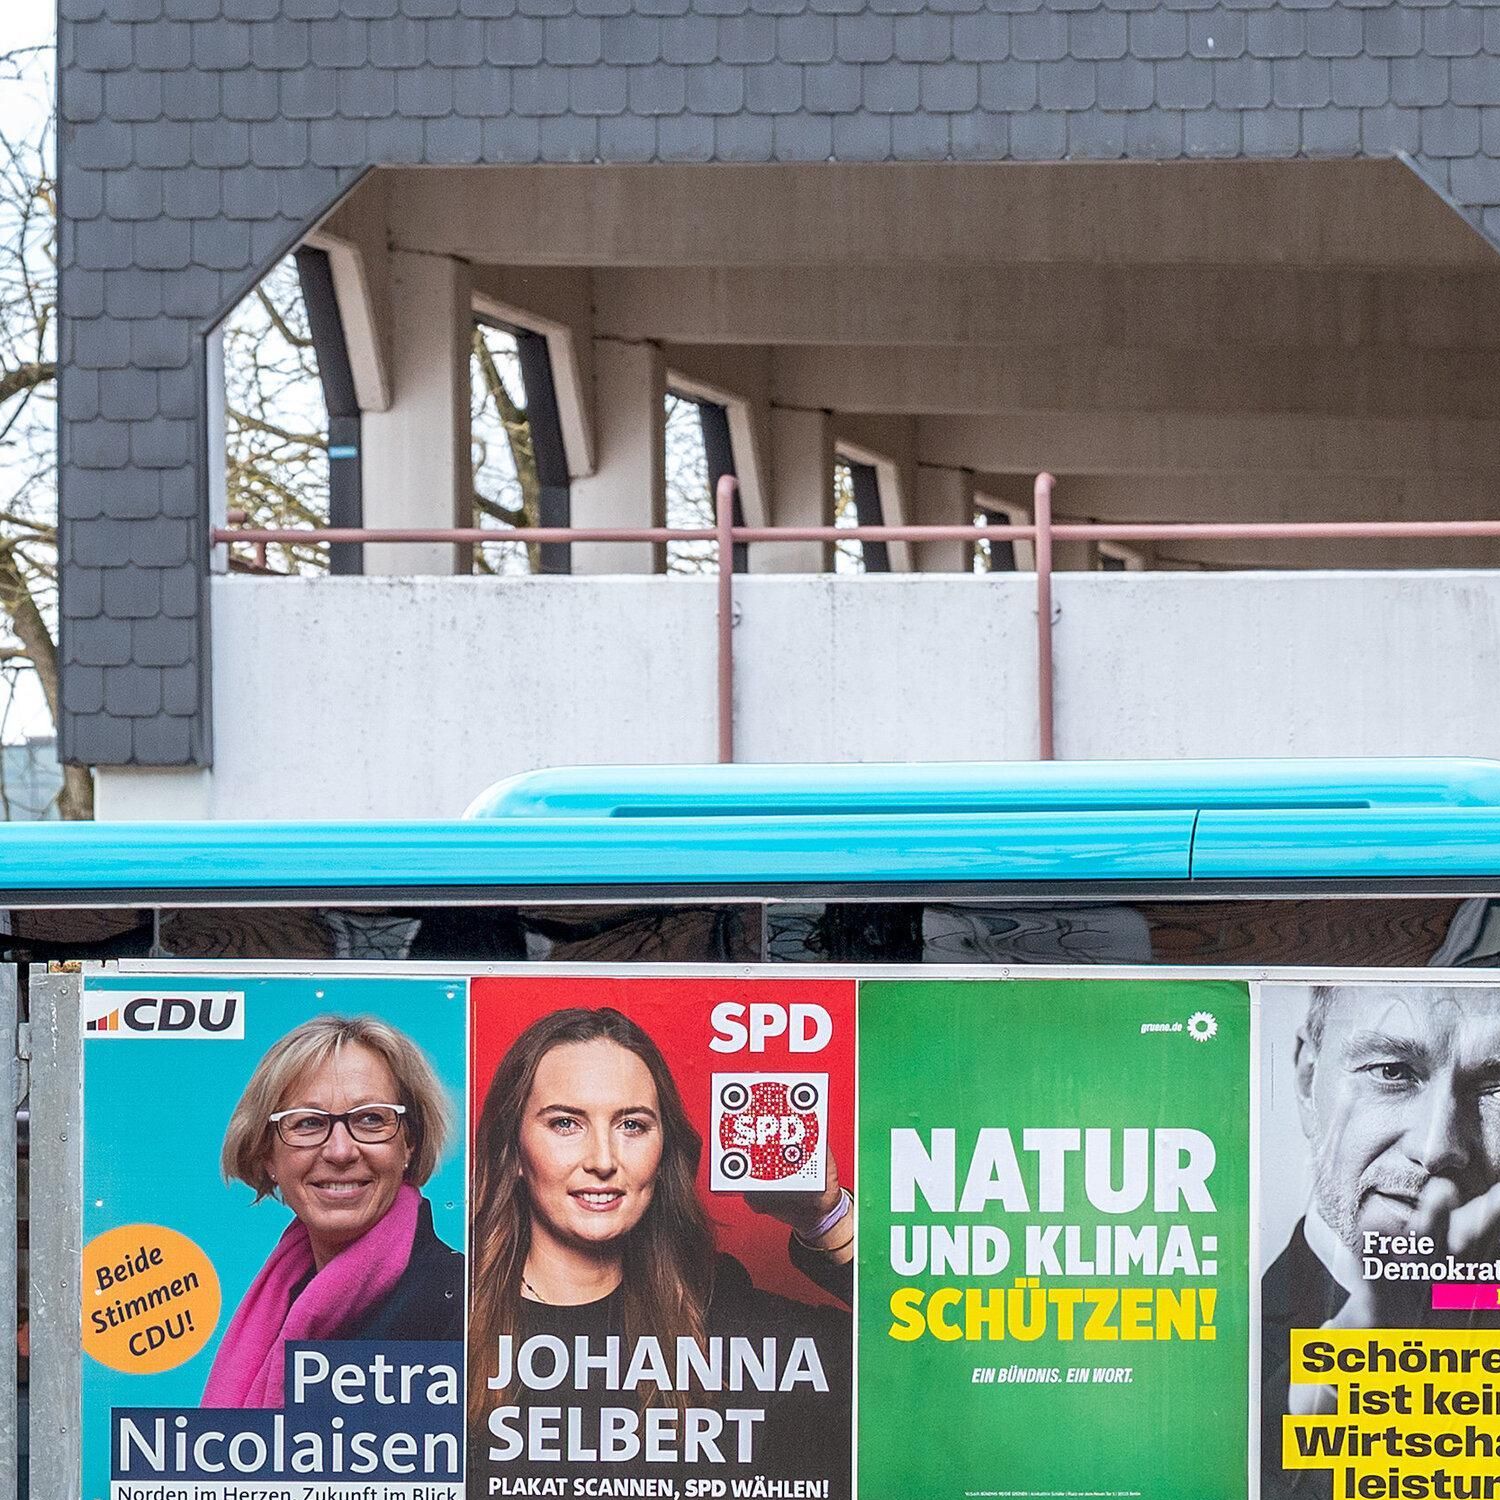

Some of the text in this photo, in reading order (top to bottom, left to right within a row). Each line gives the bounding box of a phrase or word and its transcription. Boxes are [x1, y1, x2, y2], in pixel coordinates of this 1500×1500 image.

[122, 998, 238, 1032] CDU
[709, 1002, 833, 1053] SPD
[732, 1115, 806, 1147] SPD
[889, 1128, 1217, 1213] NATUR
[96, 1243, 164, 1292] Beide
[890, 1226, 1217, 1276] UND KLIMA:
[1362, 1231, 1434, 1255] Freie
[91, 1269, 200, 1334] Stimmen
[888, 1278, 1217, 1341] SCHÜTZEN!
[128, 1309, 196, 1357] CDU!
[293, 1351, 458, 1405] Petra
[487, 1334, 829, 1393] JOHANNA
[971, 1364, 1133, 1383] EIN BÜNDNIS. EIN WORT.
[1349, 1383, 1412, 1415] ist
[118, 1414, 459, 1474] Nicolaisen
[488, 1406, 765, 1463] SELBERT
[489, 1476, 829, 1500] PLAKAT SCANNEN, SPD WÄHLEN!
